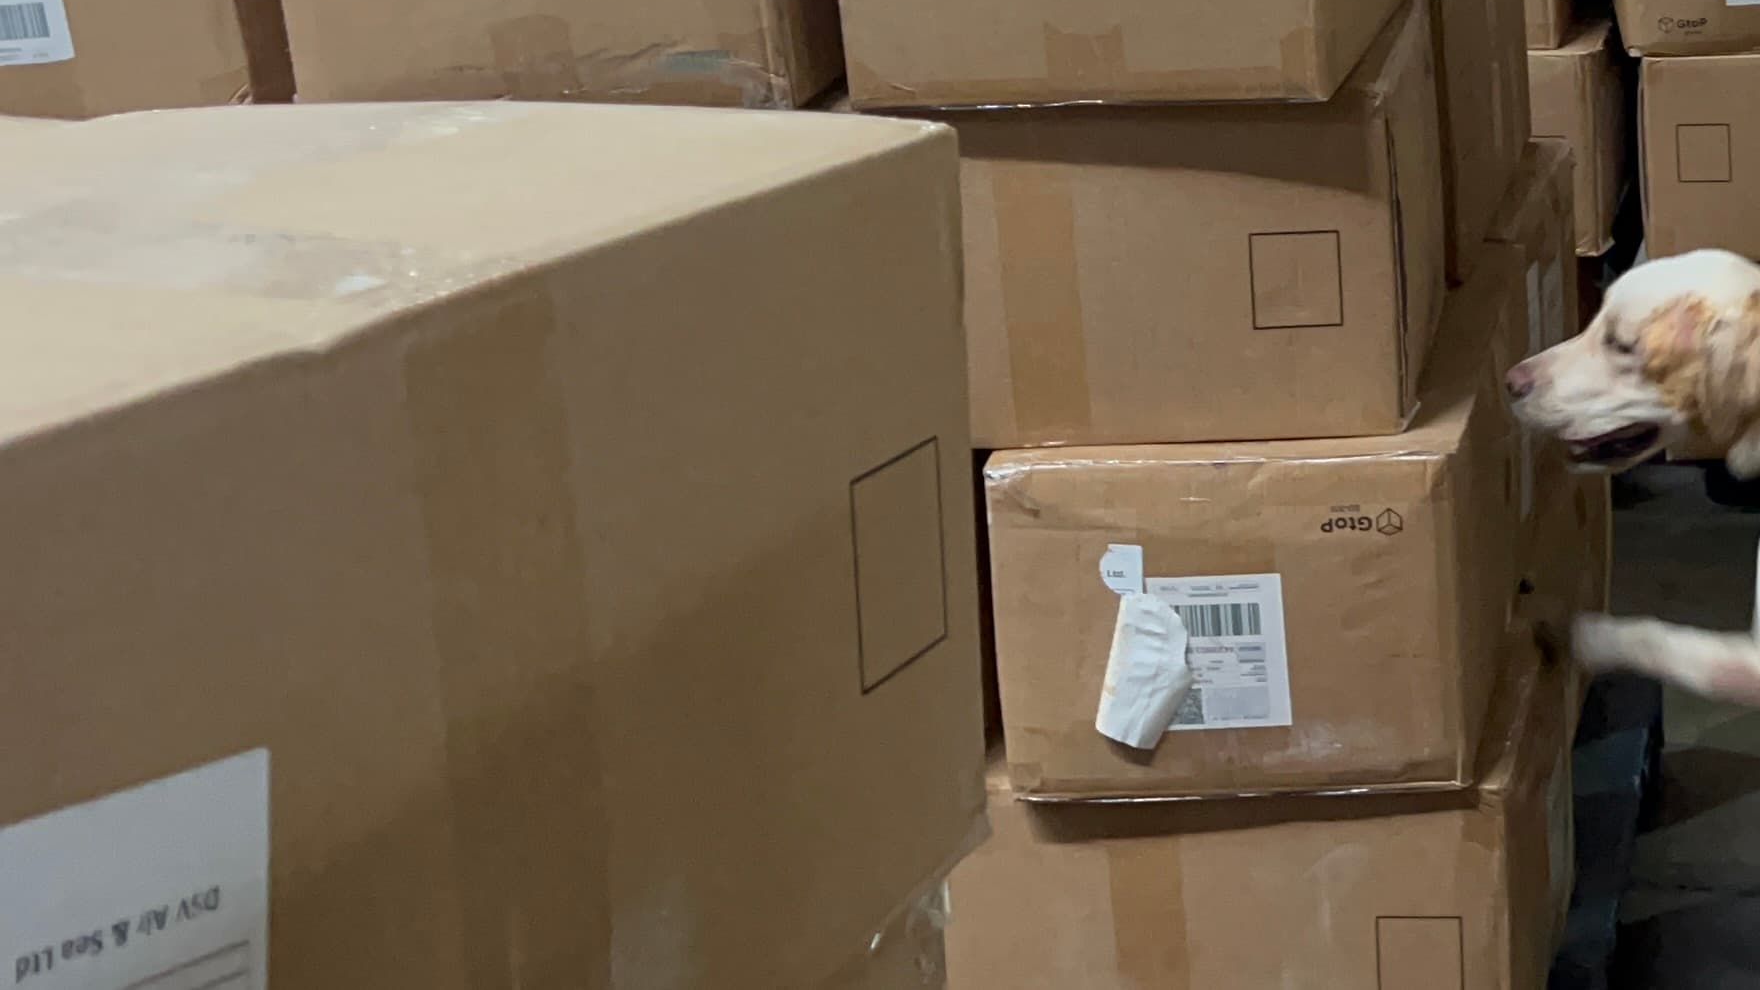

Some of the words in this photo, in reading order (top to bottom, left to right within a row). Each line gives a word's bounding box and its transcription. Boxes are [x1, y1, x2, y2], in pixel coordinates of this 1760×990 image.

[1677, 18, 1707, 28] GtoP
[1320, 516, 1373, 533] GtoP
[176, 885, 220, 923] DSV
[111, 919, 131, 947] &
[136, 905, 168, 936] Air
[61, 930, 104, 961] Sea
[15, 946, 54, 984] Ltd
